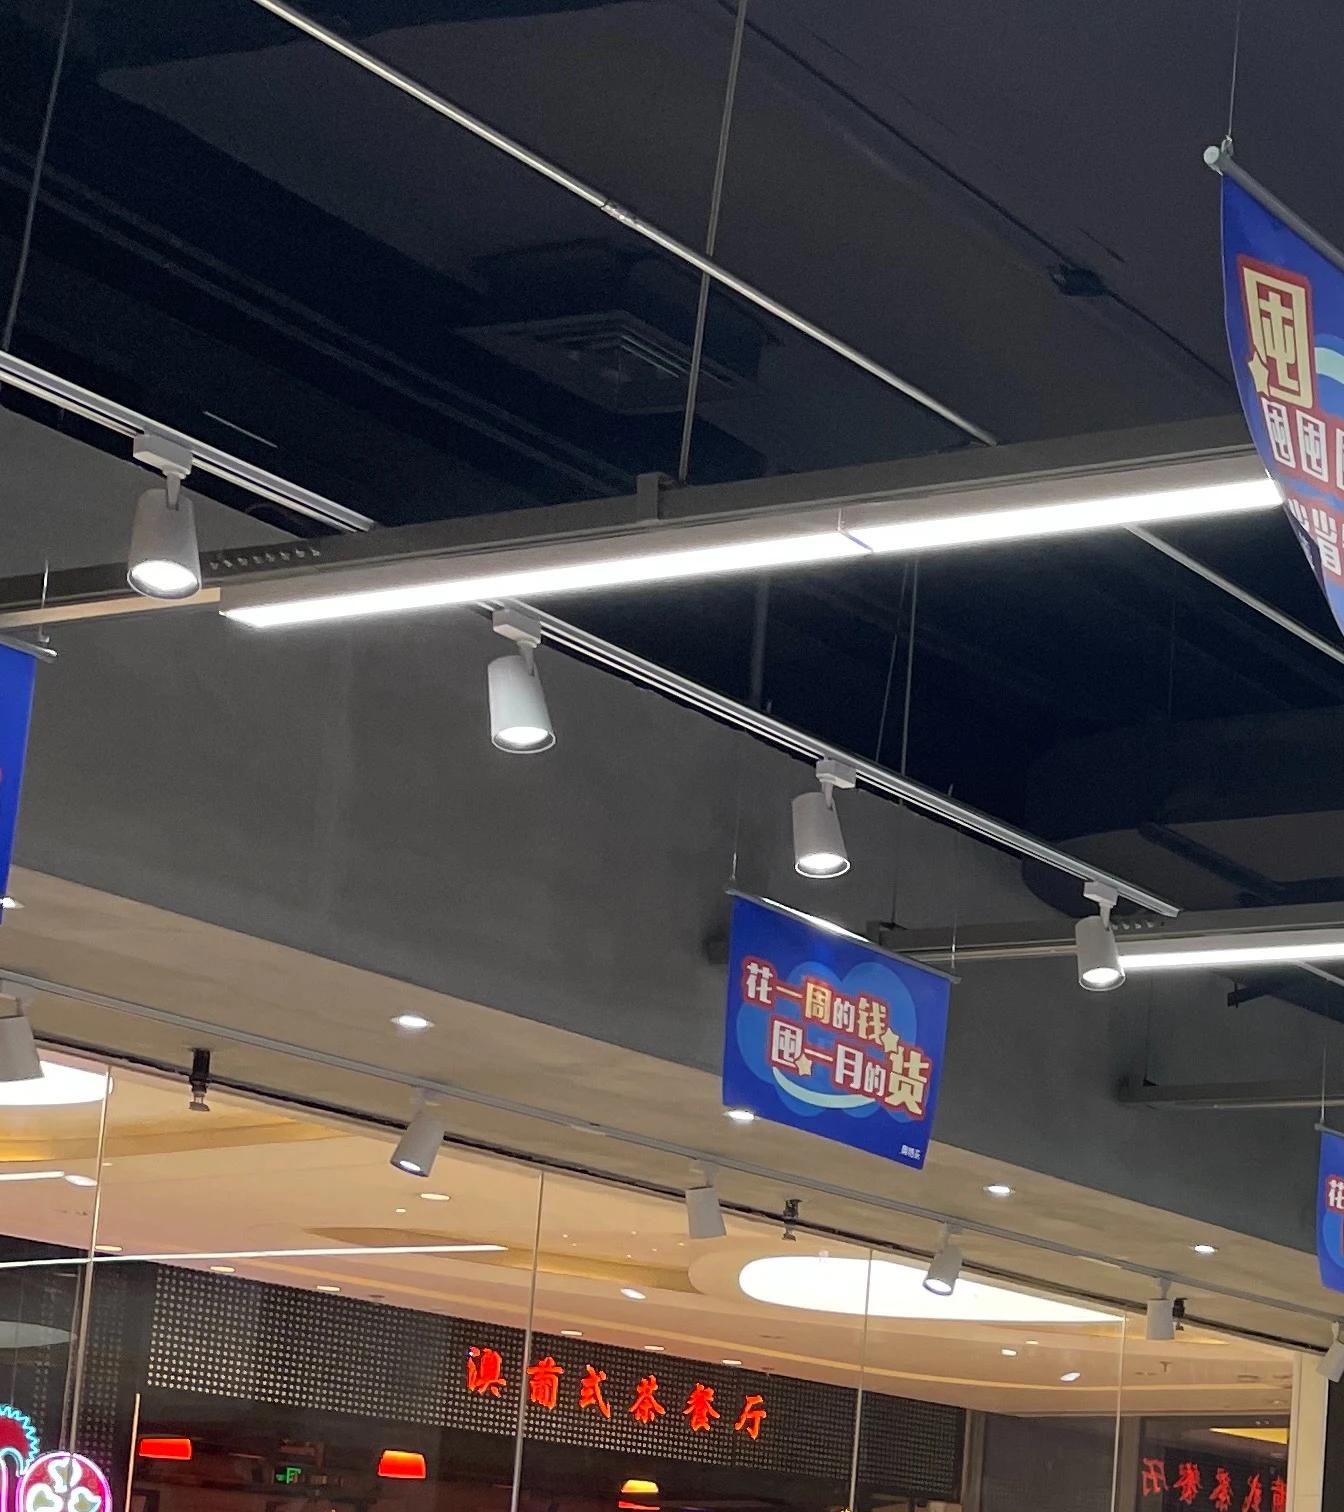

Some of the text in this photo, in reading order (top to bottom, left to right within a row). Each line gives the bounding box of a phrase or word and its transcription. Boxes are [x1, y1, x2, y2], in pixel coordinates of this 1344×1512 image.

[1241, 266, 1314, 408] 囤
[745, 961, 887, 1045] 花一周的钱
[771, 1019, 930, 1115] 囤一月的货
